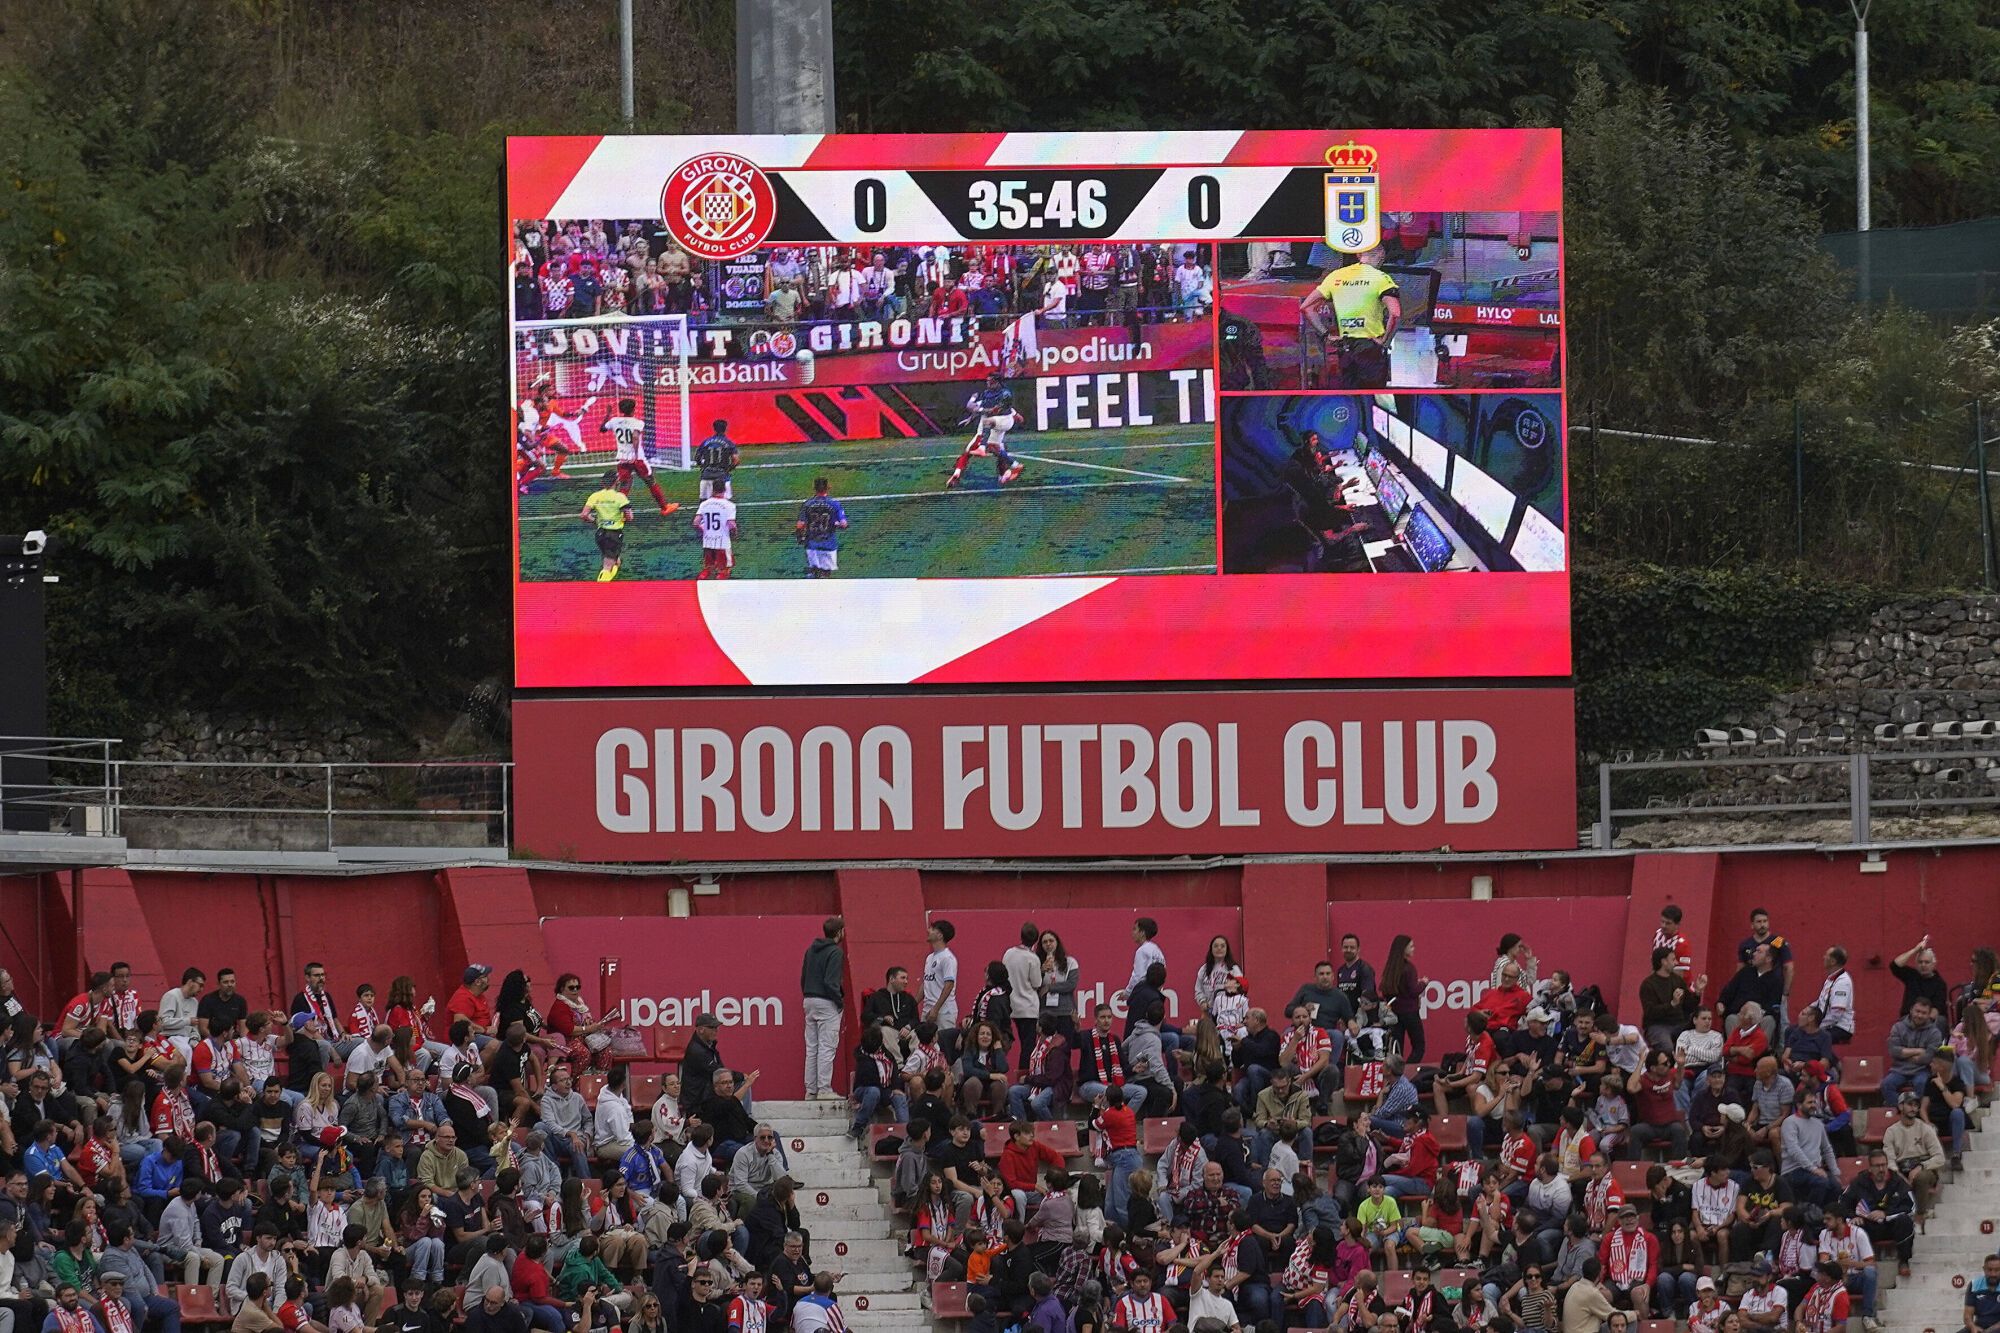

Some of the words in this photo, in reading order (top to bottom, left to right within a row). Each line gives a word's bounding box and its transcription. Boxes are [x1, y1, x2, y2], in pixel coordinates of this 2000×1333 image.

[681, 157, 755, 184] GIRONA
[854, 178, 887, 233] 0
[968, 179, 1107, 229] 35:46
[1188, 175, 1220, 230] 0
[683, 232, 726, 253] FUTBOL
[729, 231, 756, 250] CLUB
[1518, 248, 1529, 257] 01
[1477, 306, 1512, 320] HYLO
[1540, 313, 1561, 325] LAL
[898, 336, 1153, 376] GrupApodium
[632, 362, 788, 386] axaBank
[1035, 371, 1154, 432] FEEL
[615, 427, 633, 444] 20
[704, 512, 721, 531] 15
[595, 724, 914, 833] GIRONA
[942, 721, 1261, 831] FUTBOL
[1283, 719, 1498, 827] CLUB
[608, 963, 617, 976] F
[630, 989, 784, 1027] parlem
[1077, 981, 1179, 1019] rle
[819, 1195, 828, 1203] 12
[838, 1245, 845, 1253] 11
[857, 1299, 867, 1307] 10
